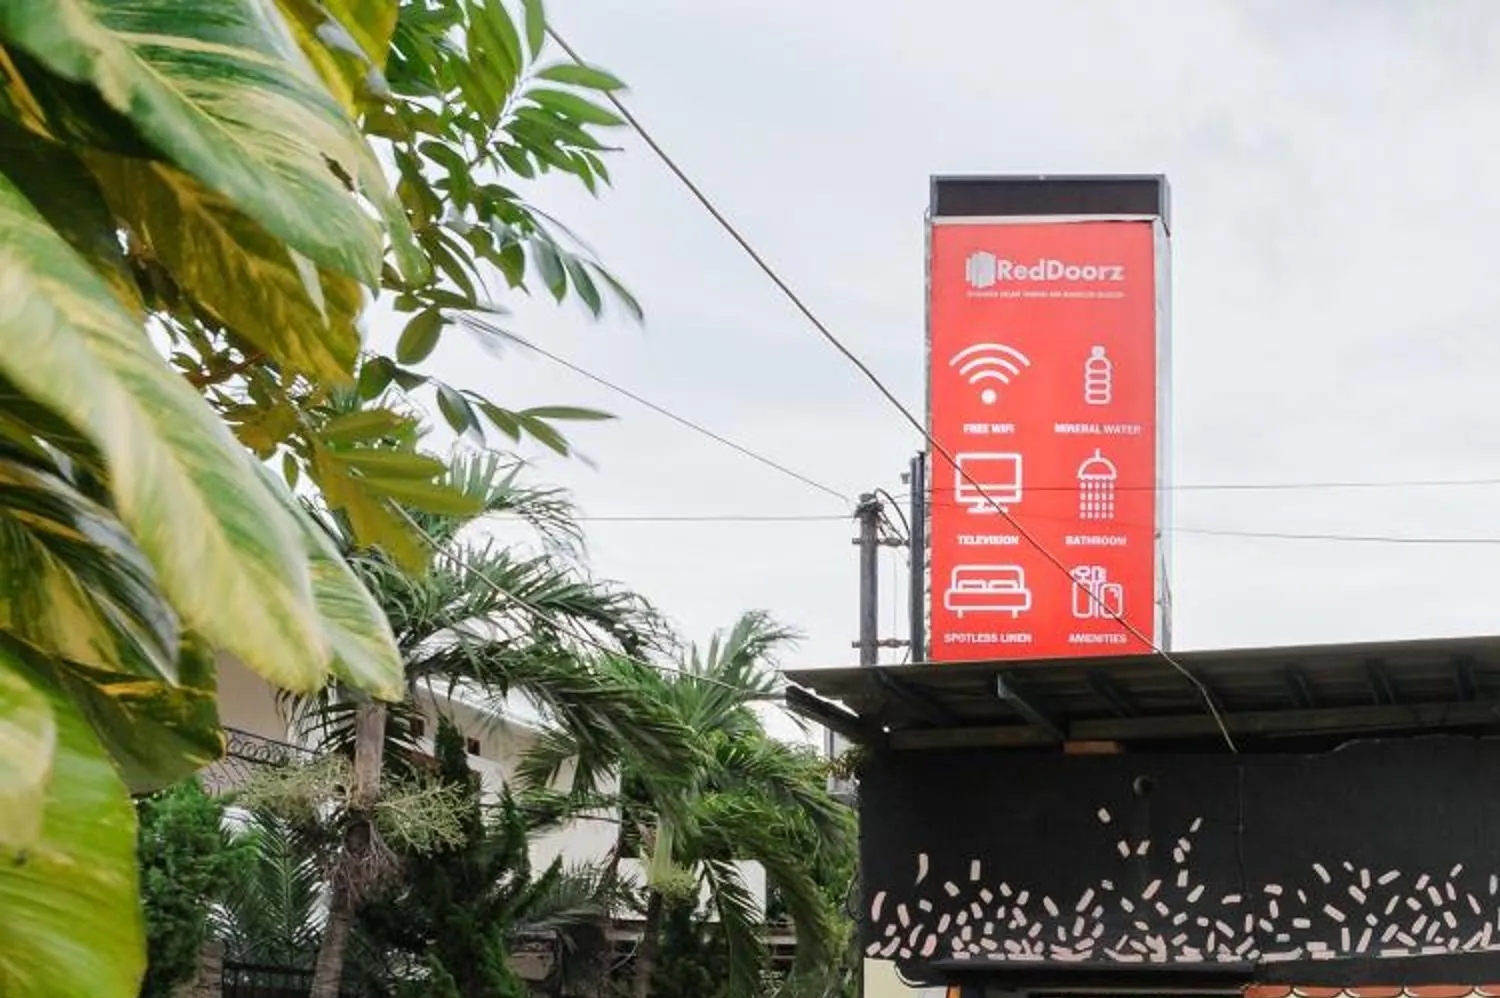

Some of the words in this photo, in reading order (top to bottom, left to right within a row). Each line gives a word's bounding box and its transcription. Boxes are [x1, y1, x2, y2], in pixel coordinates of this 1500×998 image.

[997, 259, 1124, 281] RedDoorz
[963, 423, 989, 434] FREE
[991, 423, 1015, 434] WIFI
[1054, 423, 1101, 434] MINERAL
[1103, 424, 1141, 435] WATER
[957, 535, 1020, 546] TELEVISION
[1065, 535, 1127, 546] BATHROOM
[944, 633, 997, 644] SPOTLESS
[999, 633, 1032, 644] LINEN
[1068, 633, 1127, 644] AMENITIES
